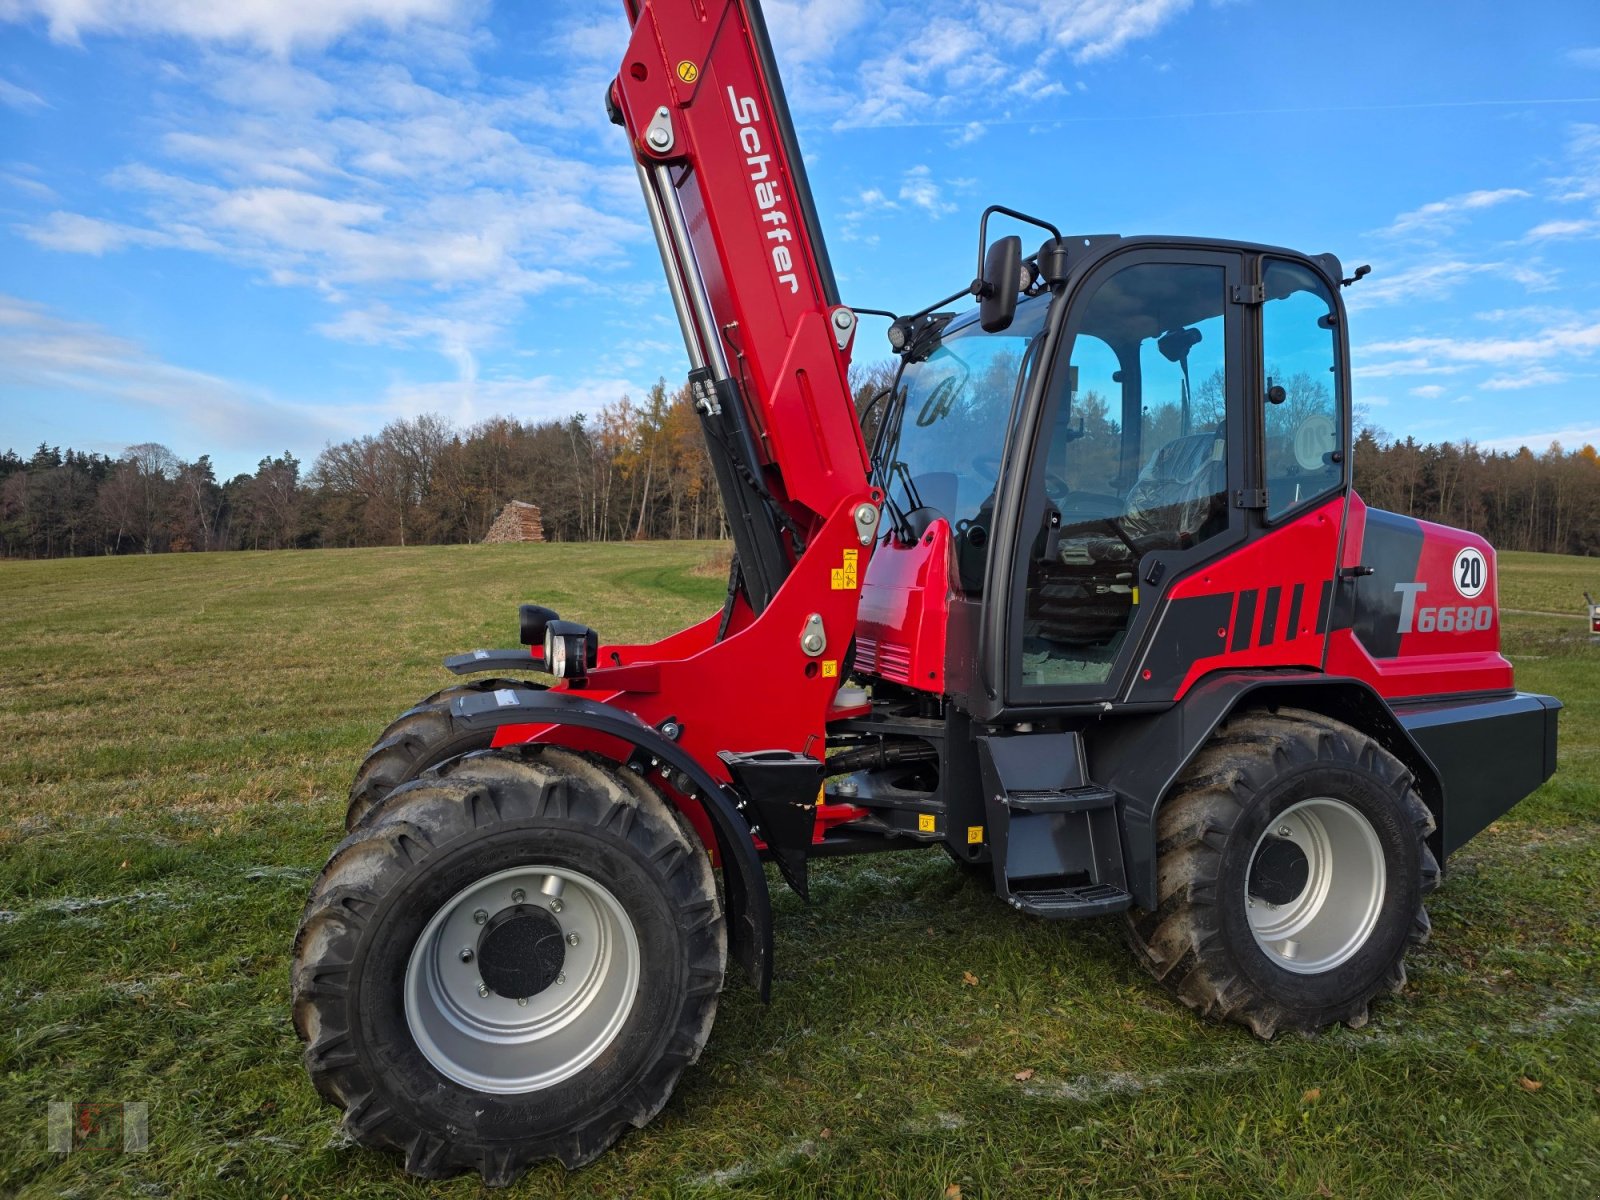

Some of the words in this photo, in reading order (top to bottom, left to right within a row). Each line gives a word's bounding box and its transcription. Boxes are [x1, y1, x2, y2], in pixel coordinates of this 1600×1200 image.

[727, 85, 799, 294] Schäffer
[1460, 557, 1481, 589] 20
[1393, 582, 1493, 634] T6680
